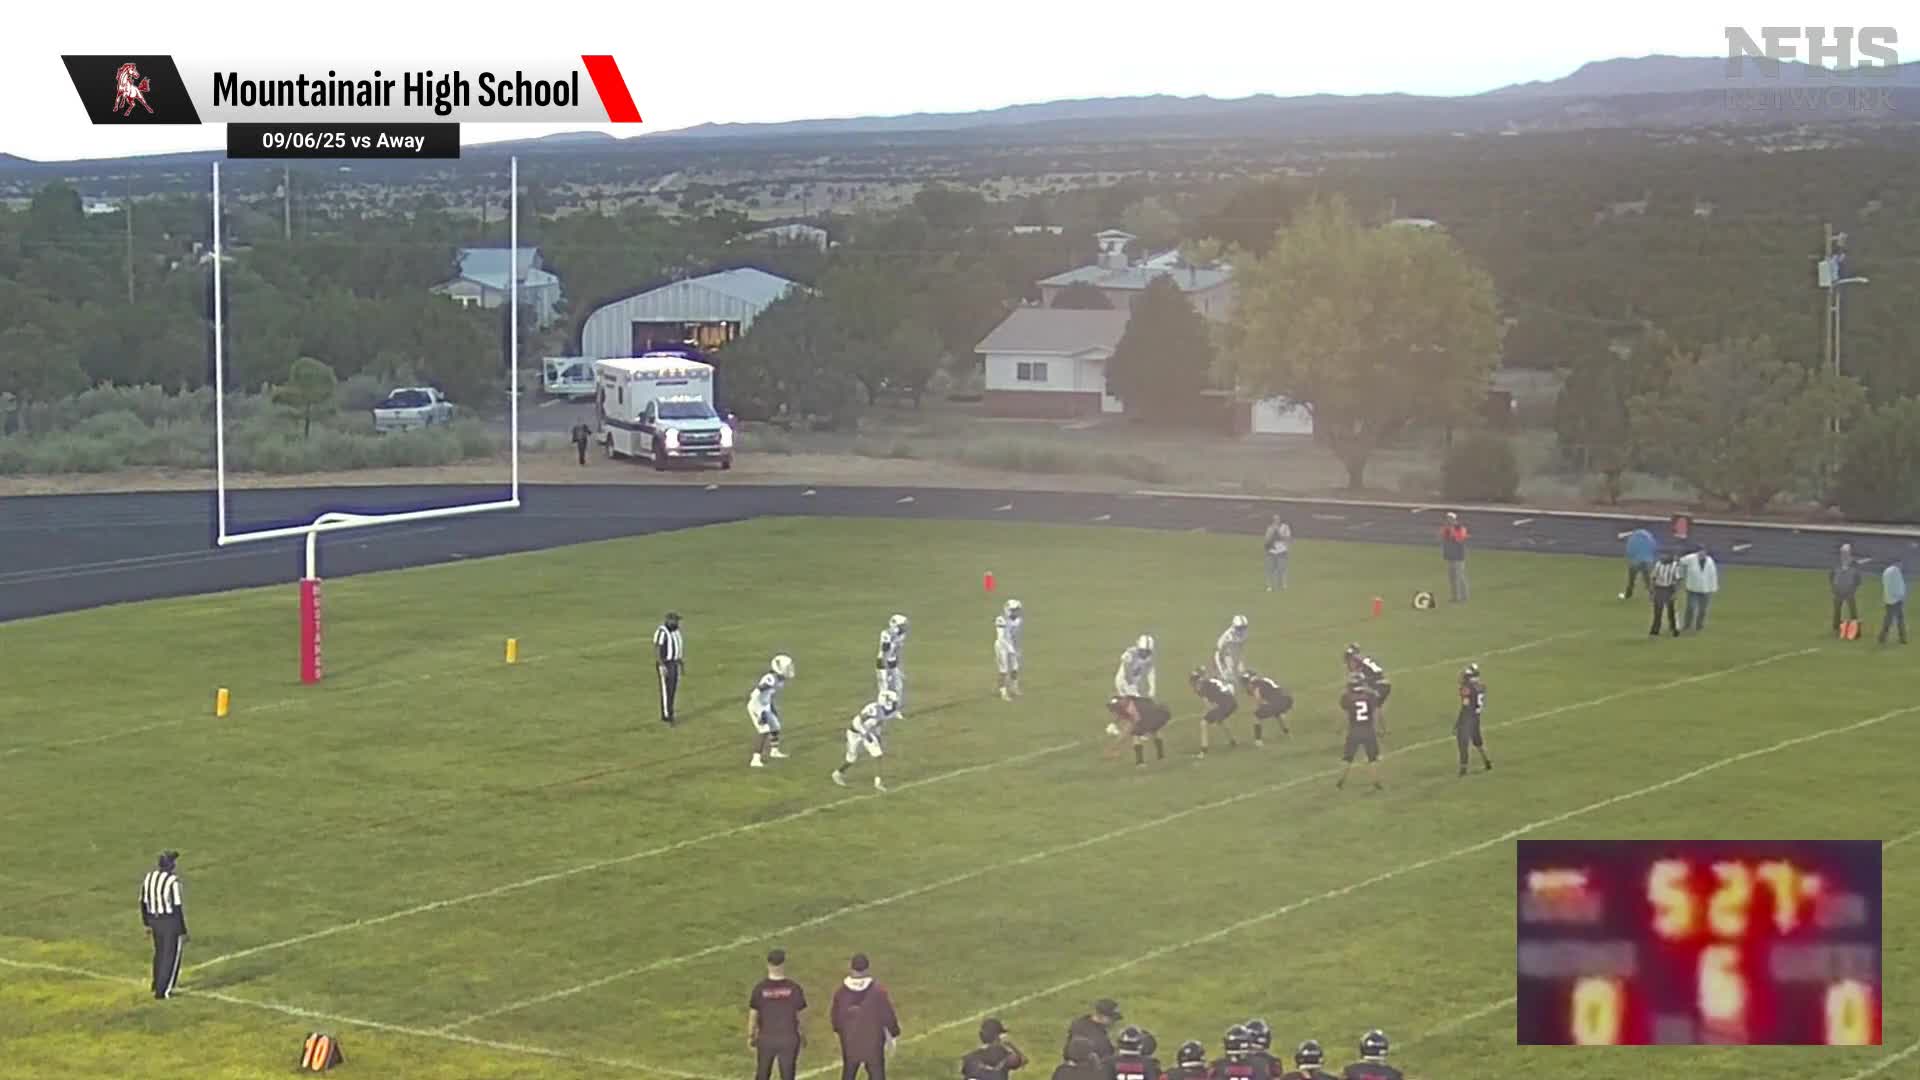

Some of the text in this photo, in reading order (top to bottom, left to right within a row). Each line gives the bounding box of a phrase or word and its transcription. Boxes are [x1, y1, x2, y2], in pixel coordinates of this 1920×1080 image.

[1414, 591, 1430, 608] G
[1354, 700, 1369, 722] 2
[1698, 944, 1745, 1020] 6
[1572, 977, 1619, 1045] 0
[1825, 979, 1870, 1045] 0
[301, 1032, 329, 1071] 10
